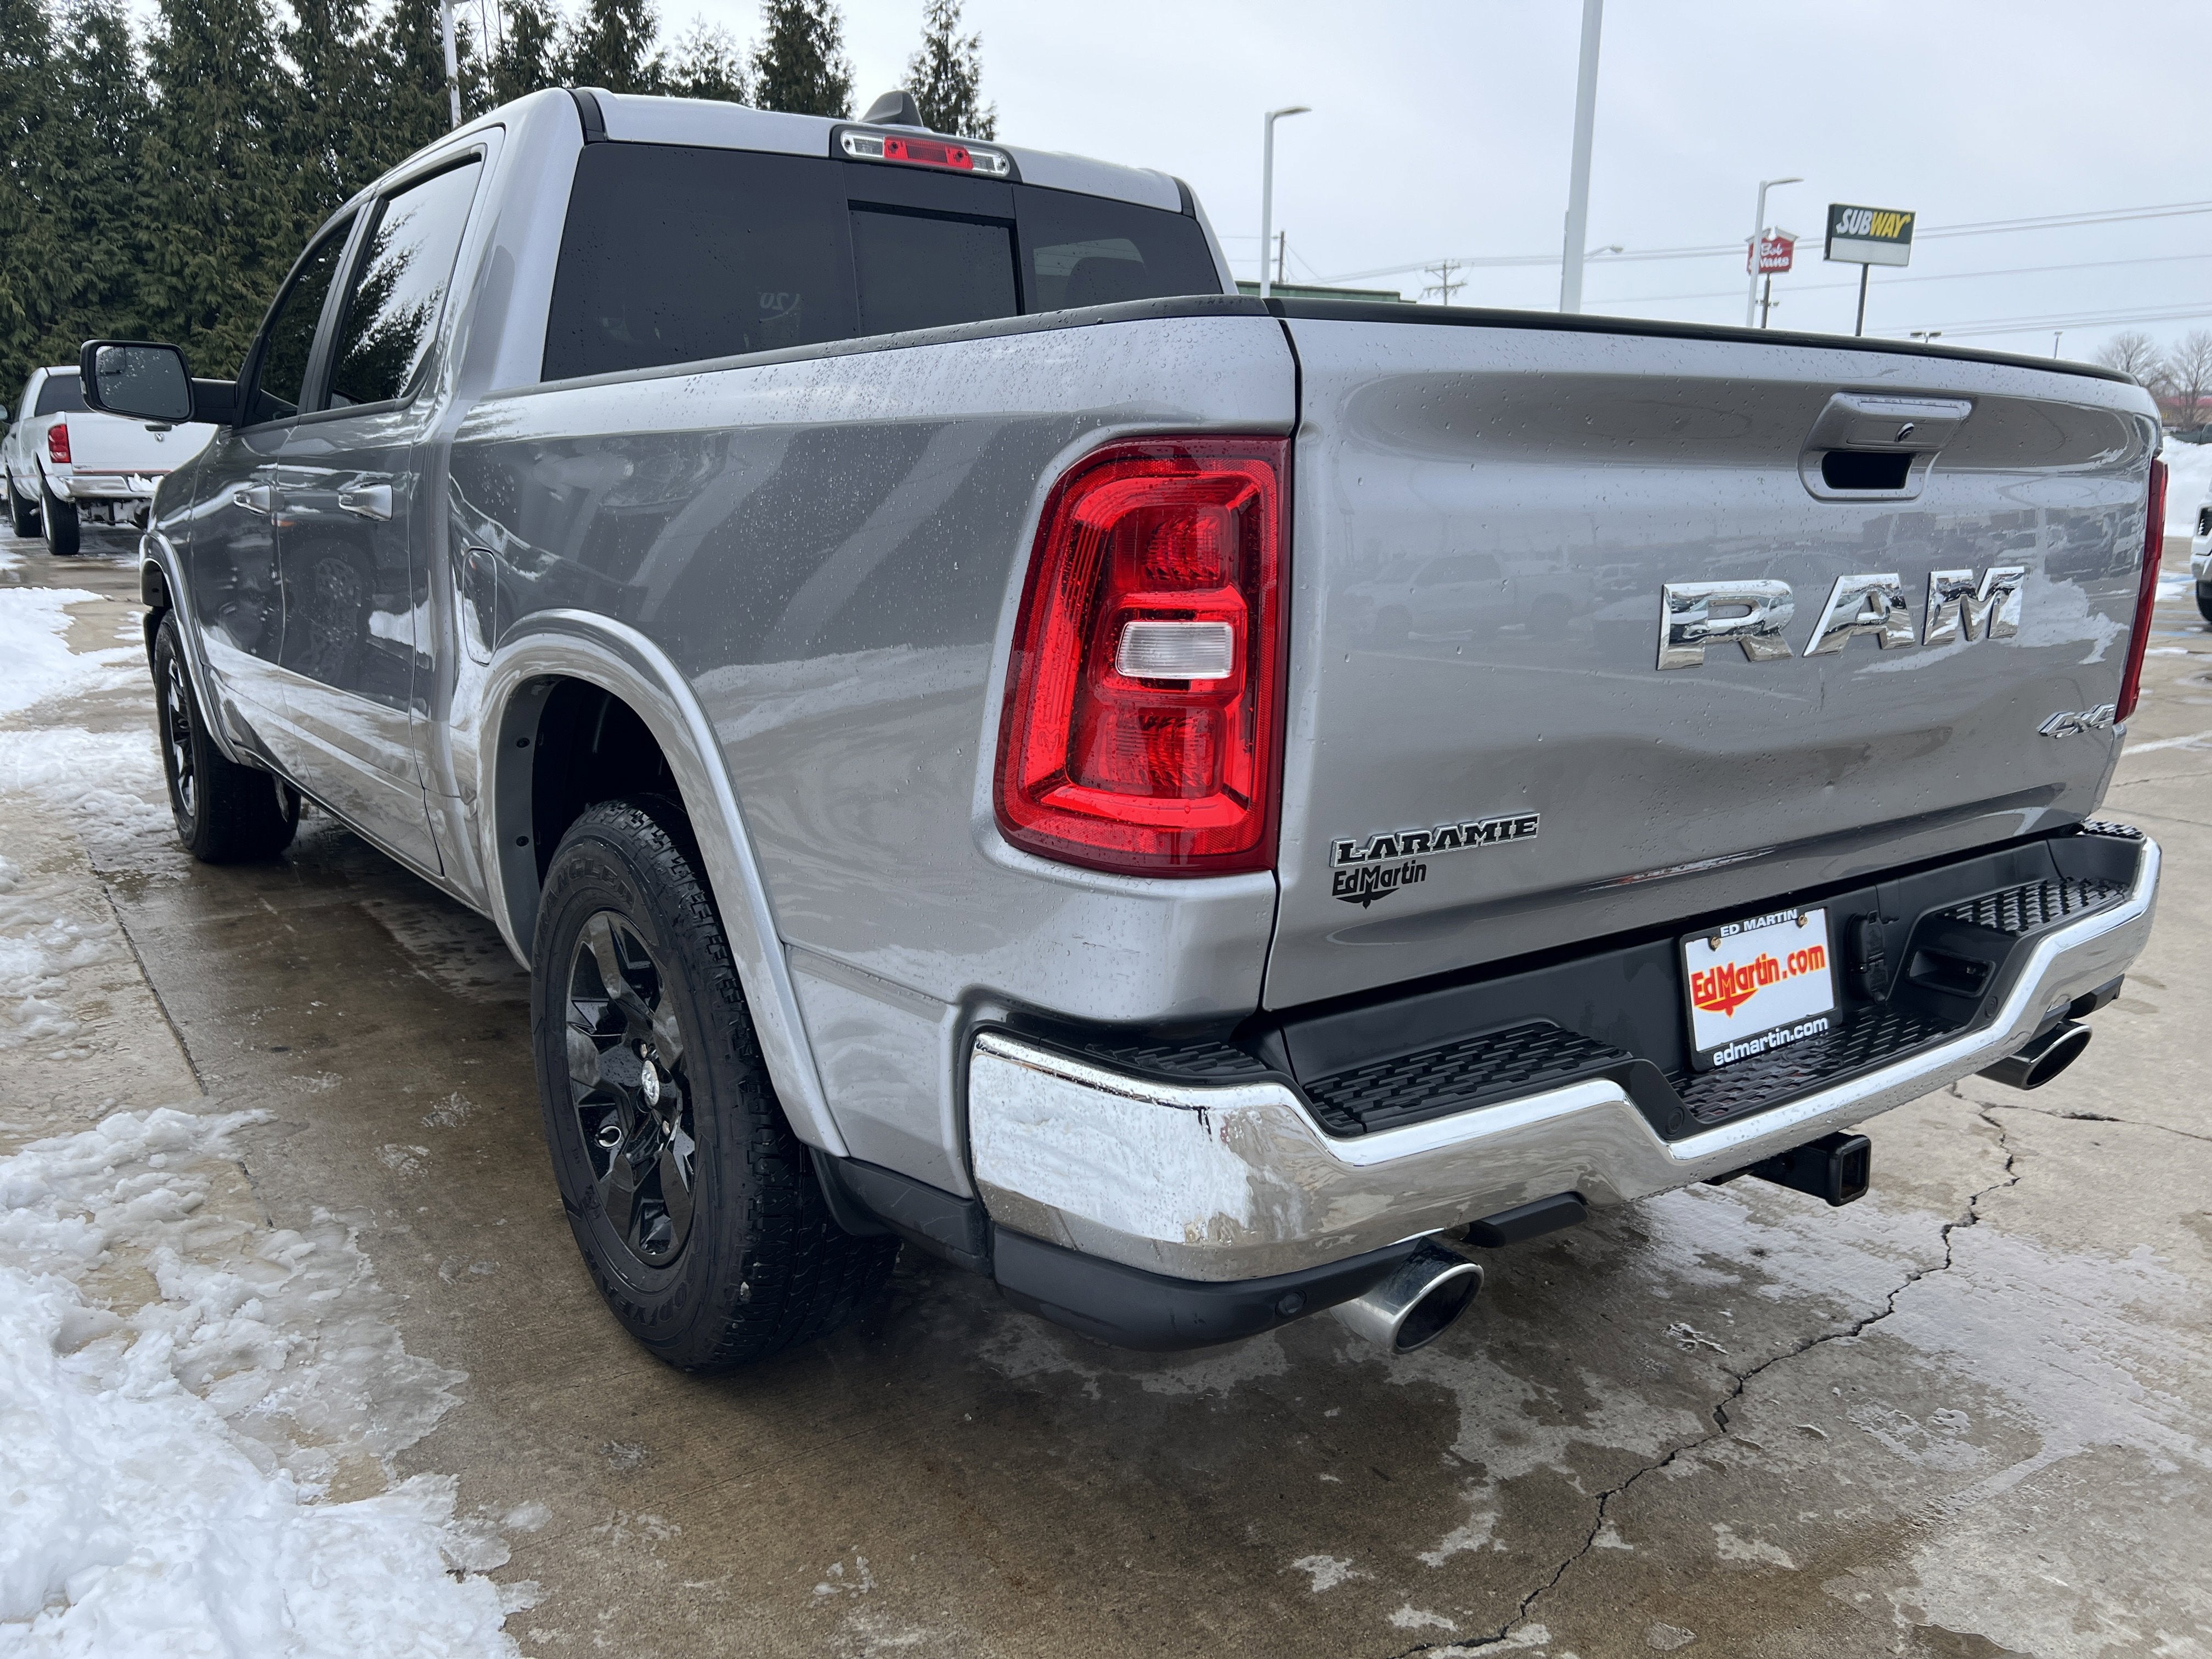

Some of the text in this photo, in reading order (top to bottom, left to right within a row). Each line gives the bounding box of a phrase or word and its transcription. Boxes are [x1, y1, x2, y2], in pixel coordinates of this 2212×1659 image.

[1836, 208, 1911, 238] SUBWAY
[1749, 256, 1789, 269] vans
[1760, 242, 1783, 256] Bob
[1656, 566, 2025, 670] RAM
[1329, 812, 1540, 867] LARAMIE
[1720, 909, 1798, 938] ED MARTIN
[1713, 1017, 1829, 1066] edmartin.com
